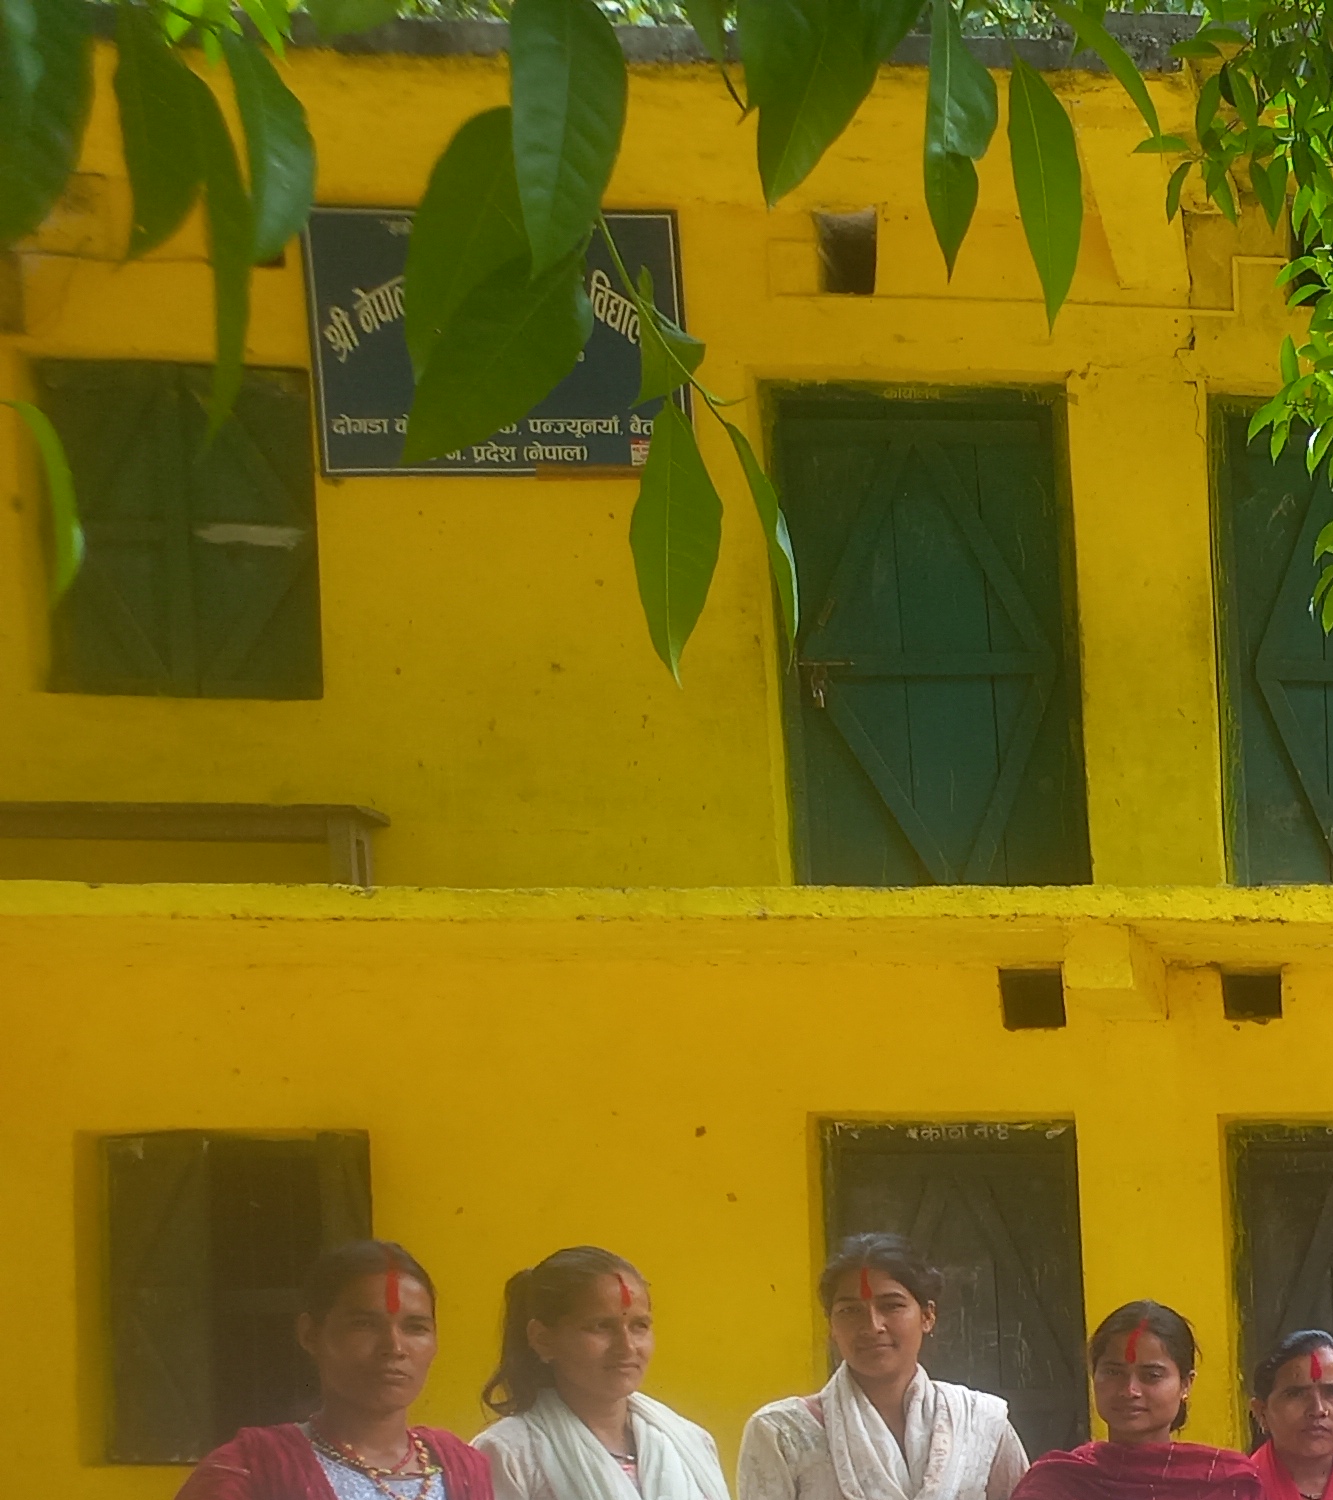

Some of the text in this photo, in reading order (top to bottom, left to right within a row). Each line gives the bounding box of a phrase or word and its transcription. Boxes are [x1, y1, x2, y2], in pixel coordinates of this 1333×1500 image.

[324, 305, 360, 363] श्री
[331, 415, 389, 435] दोगडा
[472, 442, 517, 463] प्रदेश
[523, 441, 588, 462] (नेपाल)
